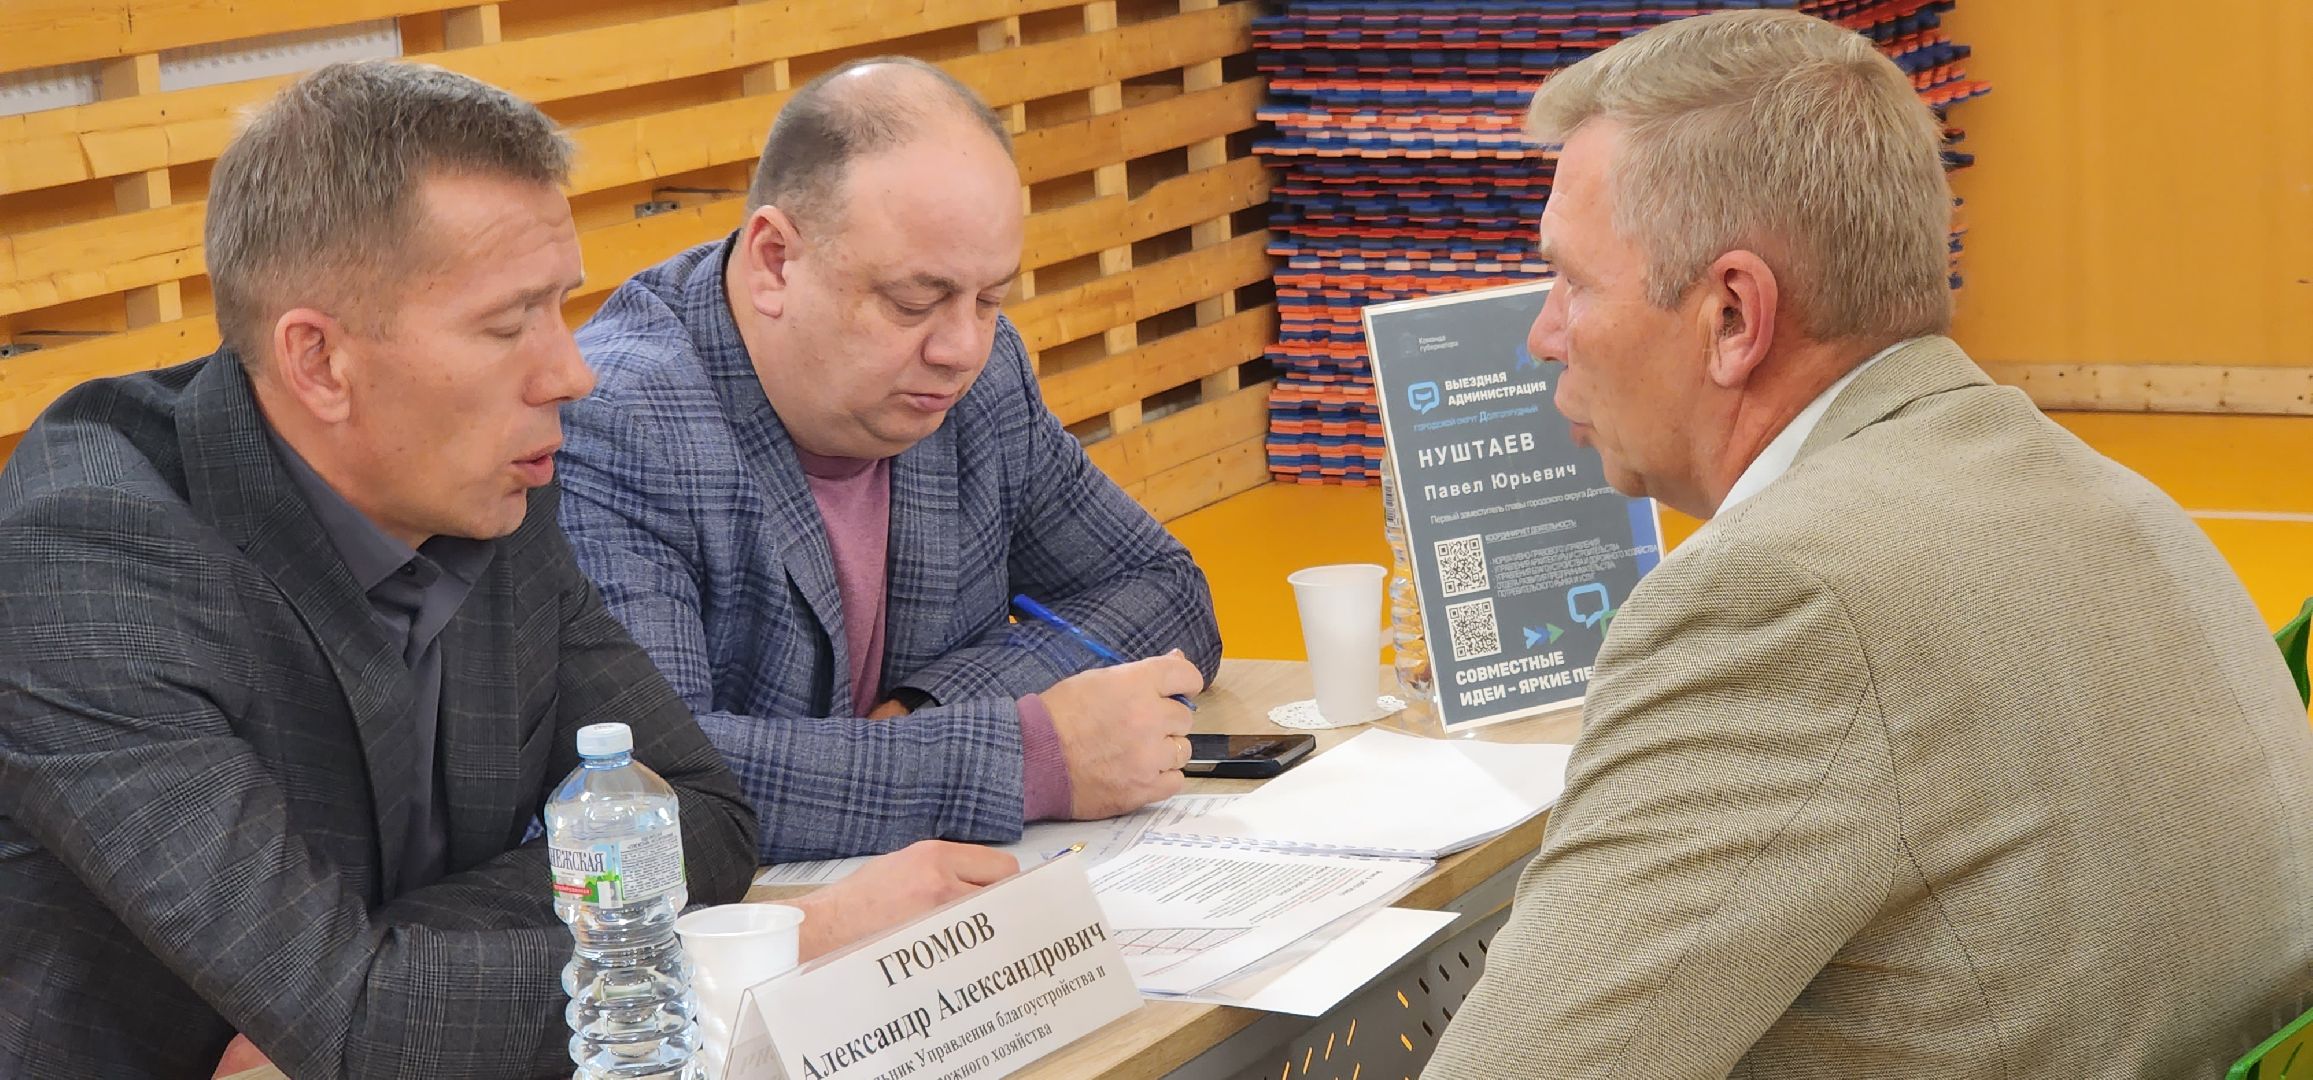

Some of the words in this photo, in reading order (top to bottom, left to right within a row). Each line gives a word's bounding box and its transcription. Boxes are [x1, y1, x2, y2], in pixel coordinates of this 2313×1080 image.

[1445, 371, 1507, 391] ВЫЕЗДНАЯ
[1448, 381, 1547, 406] АДМИНИСТРАЦИЯ
[1418, 432, 1535, 468] НУШТАЕВ
[1424, 480, 1484, 501] Павел
[1491, 464, 1577, 490] Юрьевич
[1430, 512, 1460, 525] Первый
[1456, 651, 1565, 685] СОВМЕСТНЫЕ
[1459, 685, 1507, 706] ИДЕИ
[1518, 670, 1572, 694] ЯРКИЕ
[1572, 665, 1596, 683] ПЕ
[876, 912, 995, 988] ГРОМОВ
[801, 1007, 932, 1080] Александр
[937, 922, 1107, 1021] Александрович
[914, 1022, 996, 1068] Управления
[996, 971, 1096, 1028] благоустройства
[1098, 965, 1106, 978] и
[991, 1021, 1053, 1063] хозяйства
